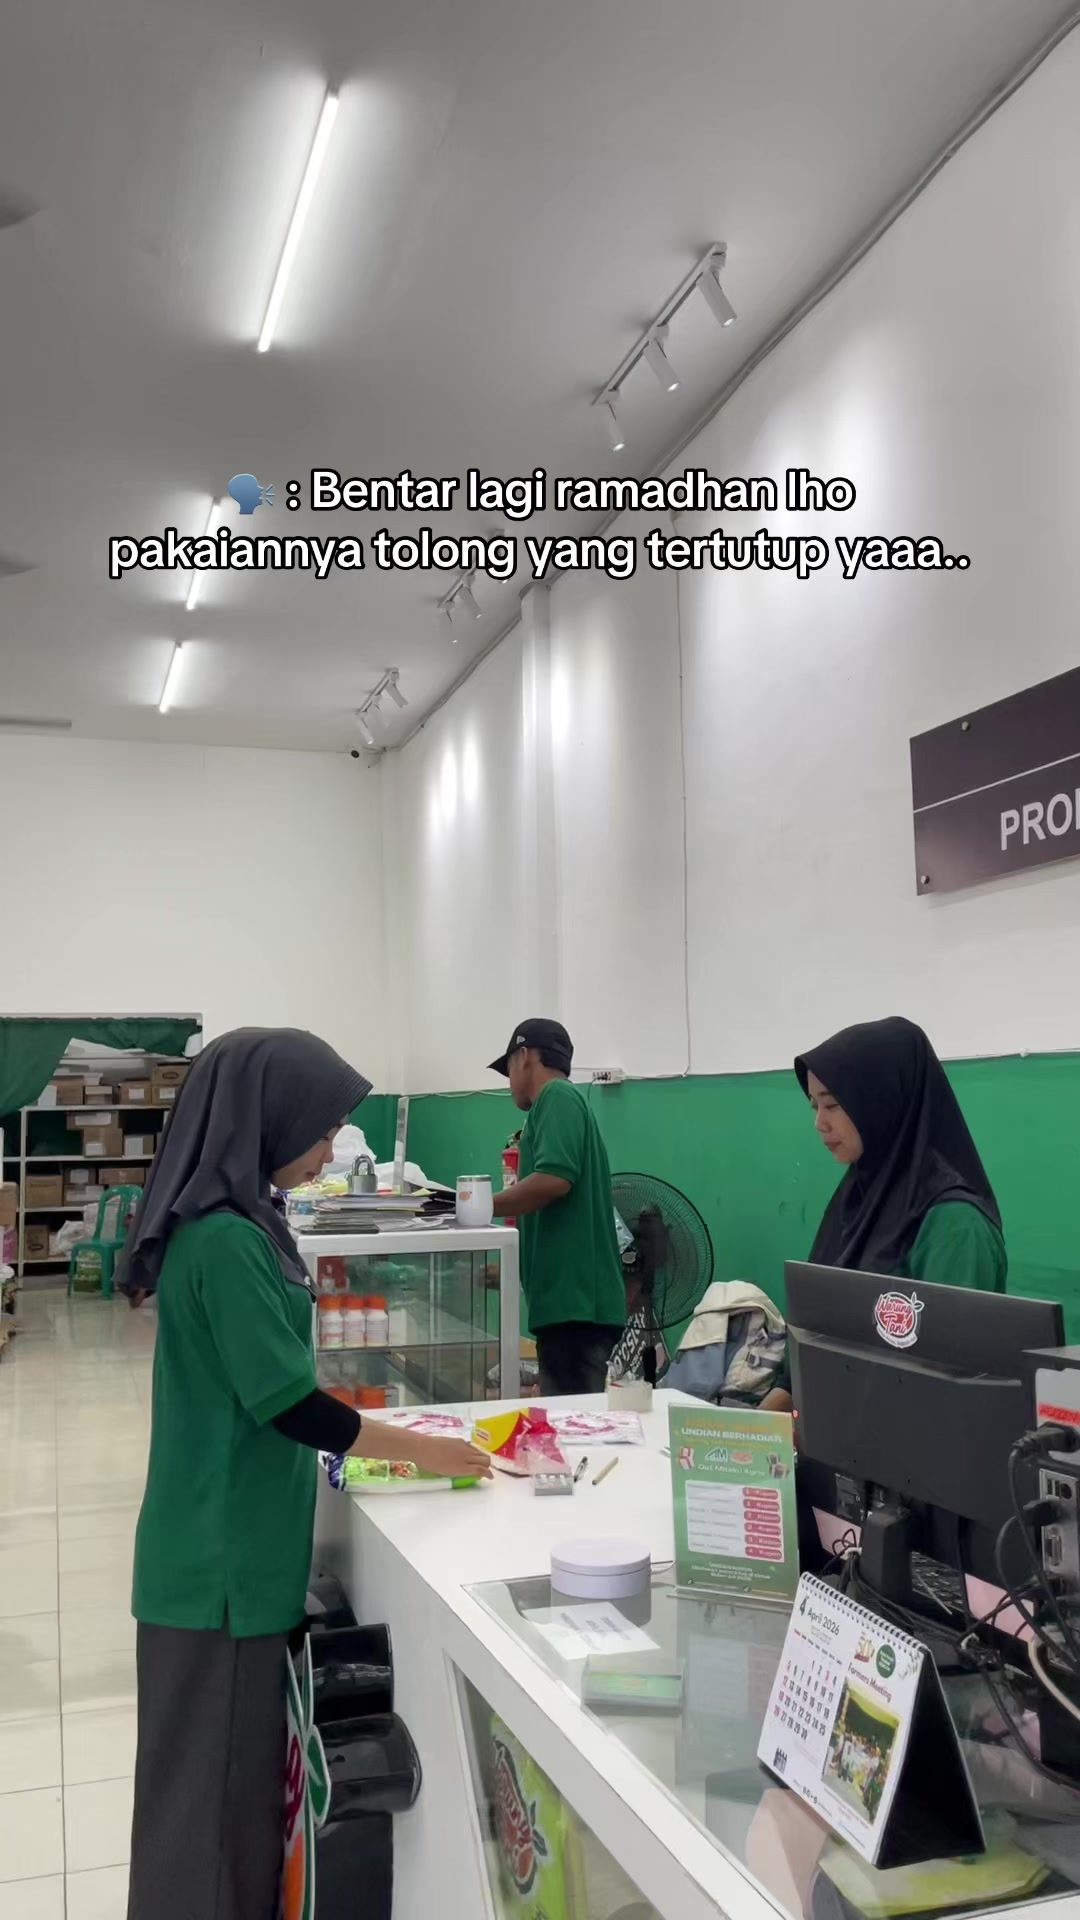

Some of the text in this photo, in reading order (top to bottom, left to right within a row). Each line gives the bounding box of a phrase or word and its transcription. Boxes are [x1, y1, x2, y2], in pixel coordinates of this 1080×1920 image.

[1001, 788, 1080, 851] PRO
[876, 1294, 914, 1320] Warung
[884, 1313, 908, 1335] Tani
[681, 1427, 720, 1438] UNDIAN
[807, 1607, 822, 1624] April
[822, 1616, 840, 1636] 2026
[847, 1662, 892, 1703] Farmers Meeting
